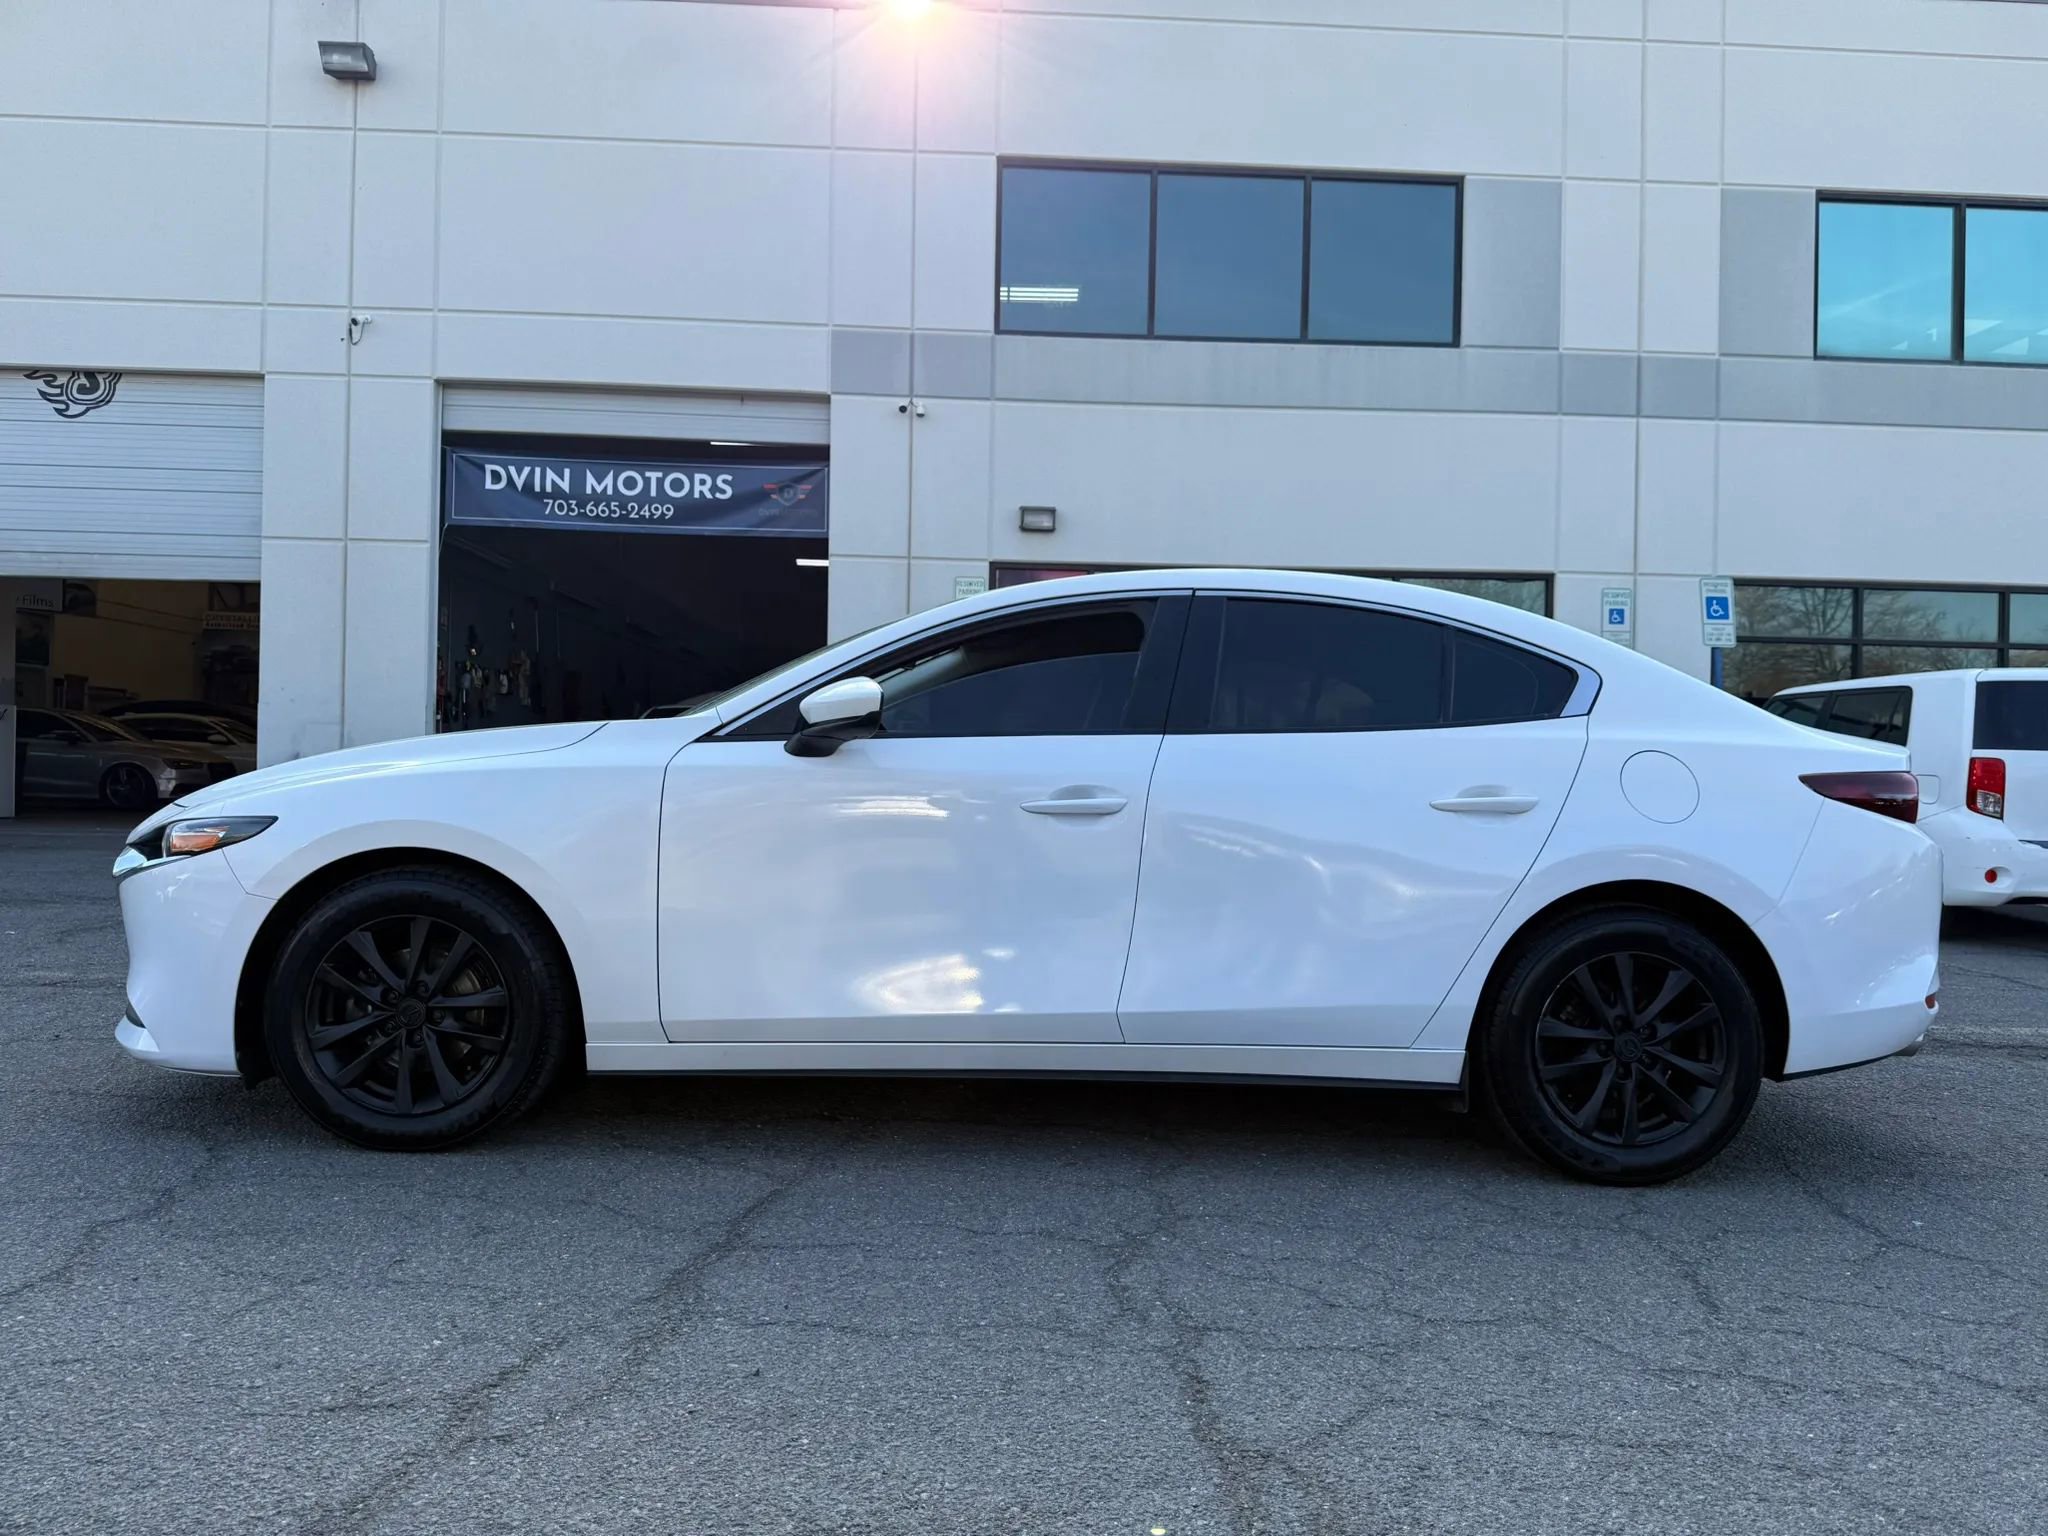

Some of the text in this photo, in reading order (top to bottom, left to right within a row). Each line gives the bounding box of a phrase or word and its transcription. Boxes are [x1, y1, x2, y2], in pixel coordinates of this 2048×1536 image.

[484, 464, 733, 500] DVIN MOTORS
[543, 499, 674, 519] 703-665-2499
